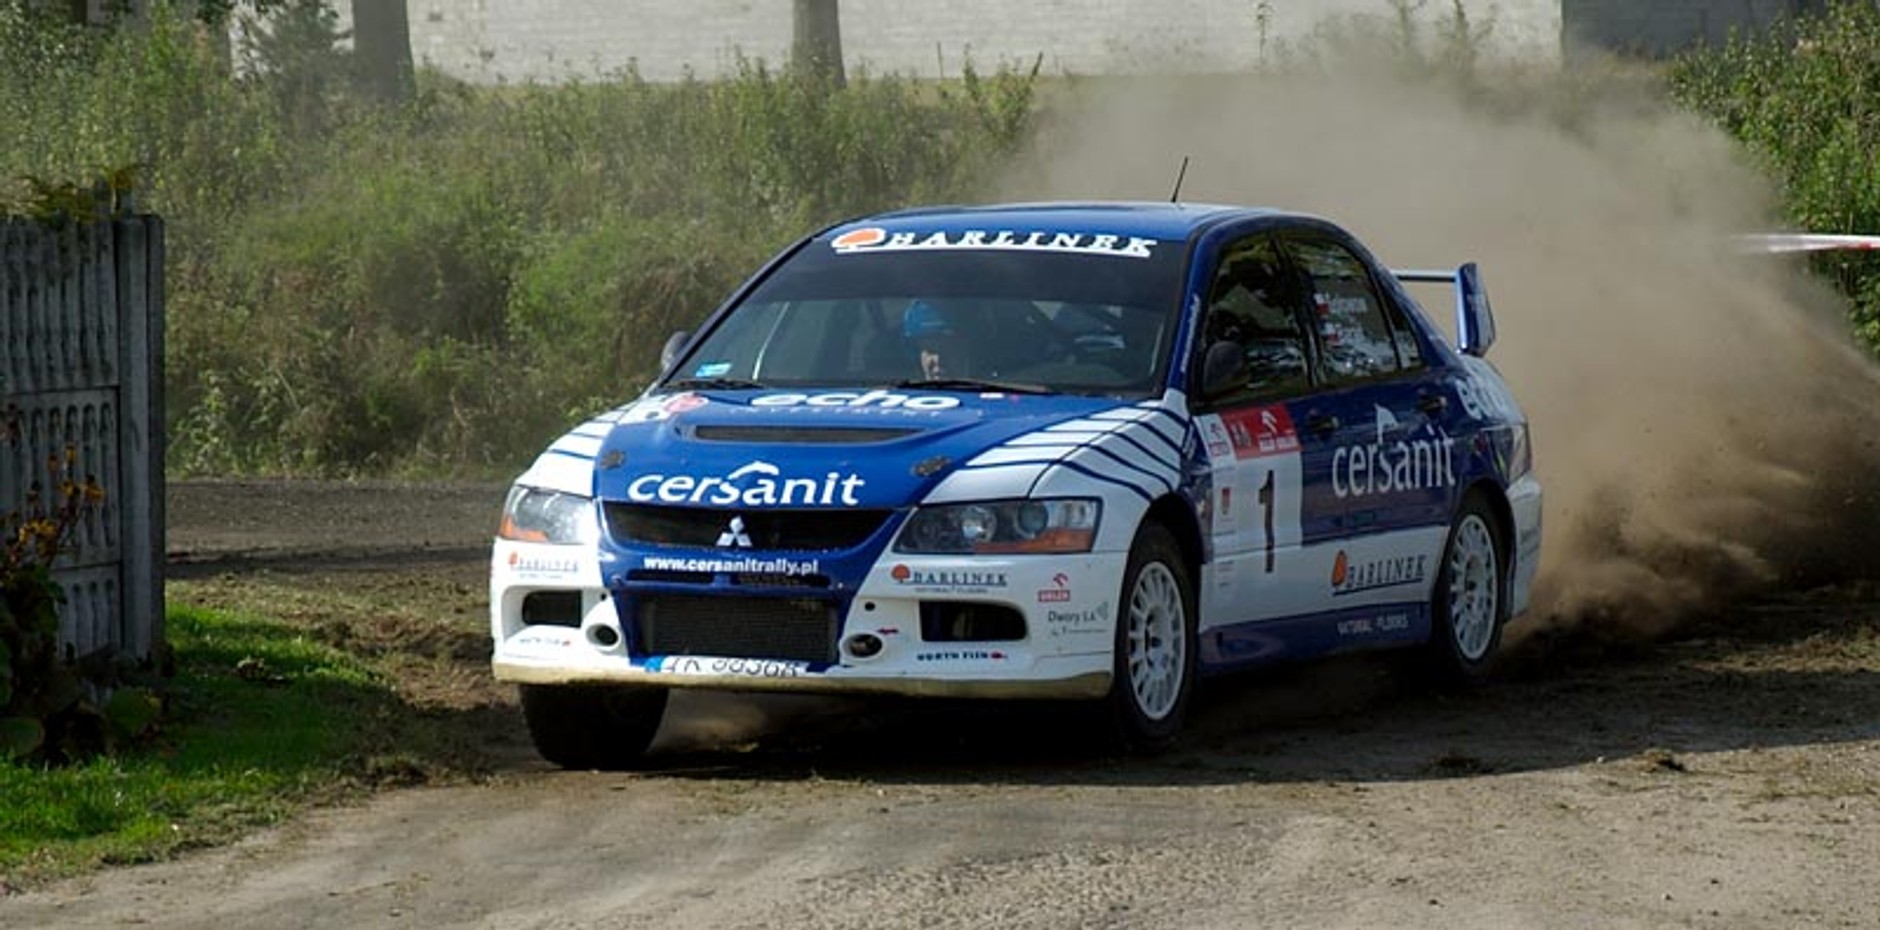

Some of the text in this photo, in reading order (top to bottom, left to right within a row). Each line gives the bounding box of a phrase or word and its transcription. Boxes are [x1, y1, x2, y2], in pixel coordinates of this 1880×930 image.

[751, 390, 961, 409] echo
[1332, 422, 1456, 498] cersanit
[628, 465, 865, 505] cersanit
[1258, 469, 1275, 573] 1
[644, 556, 819, 575] www.cersanitrally.pl
[913, 571, 1008, 587] BARLINEK
[1346, 554, 1427, 590] BARLINEK
